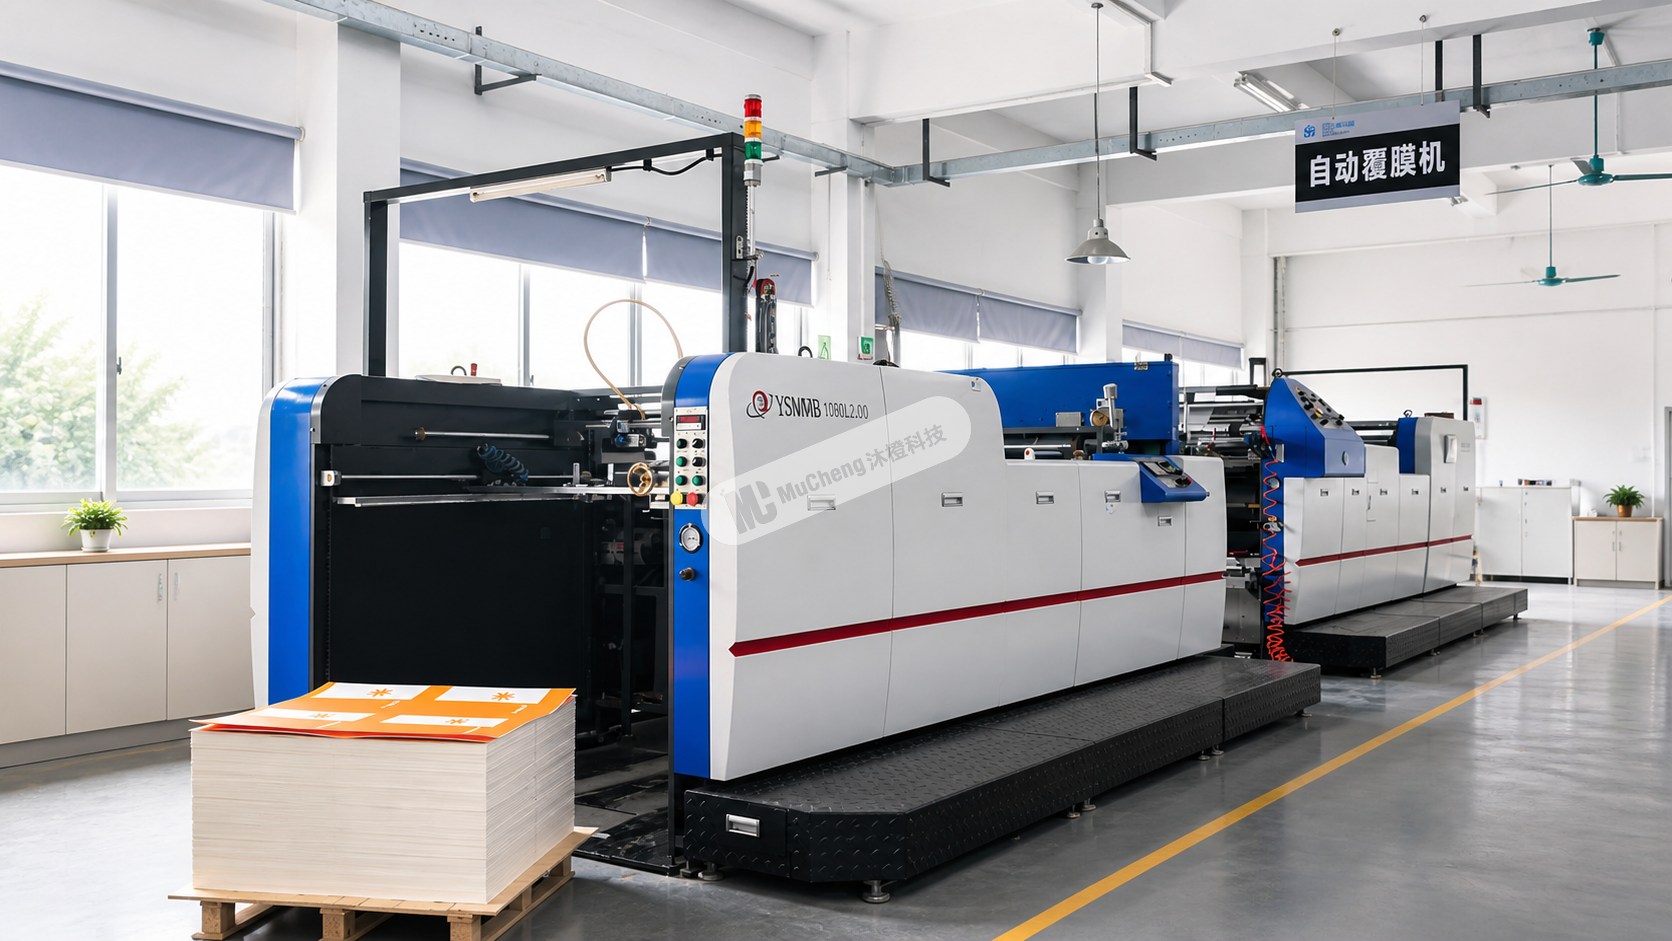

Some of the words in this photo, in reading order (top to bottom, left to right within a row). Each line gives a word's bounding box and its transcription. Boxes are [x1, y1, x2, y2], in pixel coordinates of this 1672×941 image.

[1309, 140, 1446, 188] 自动覆膜机
